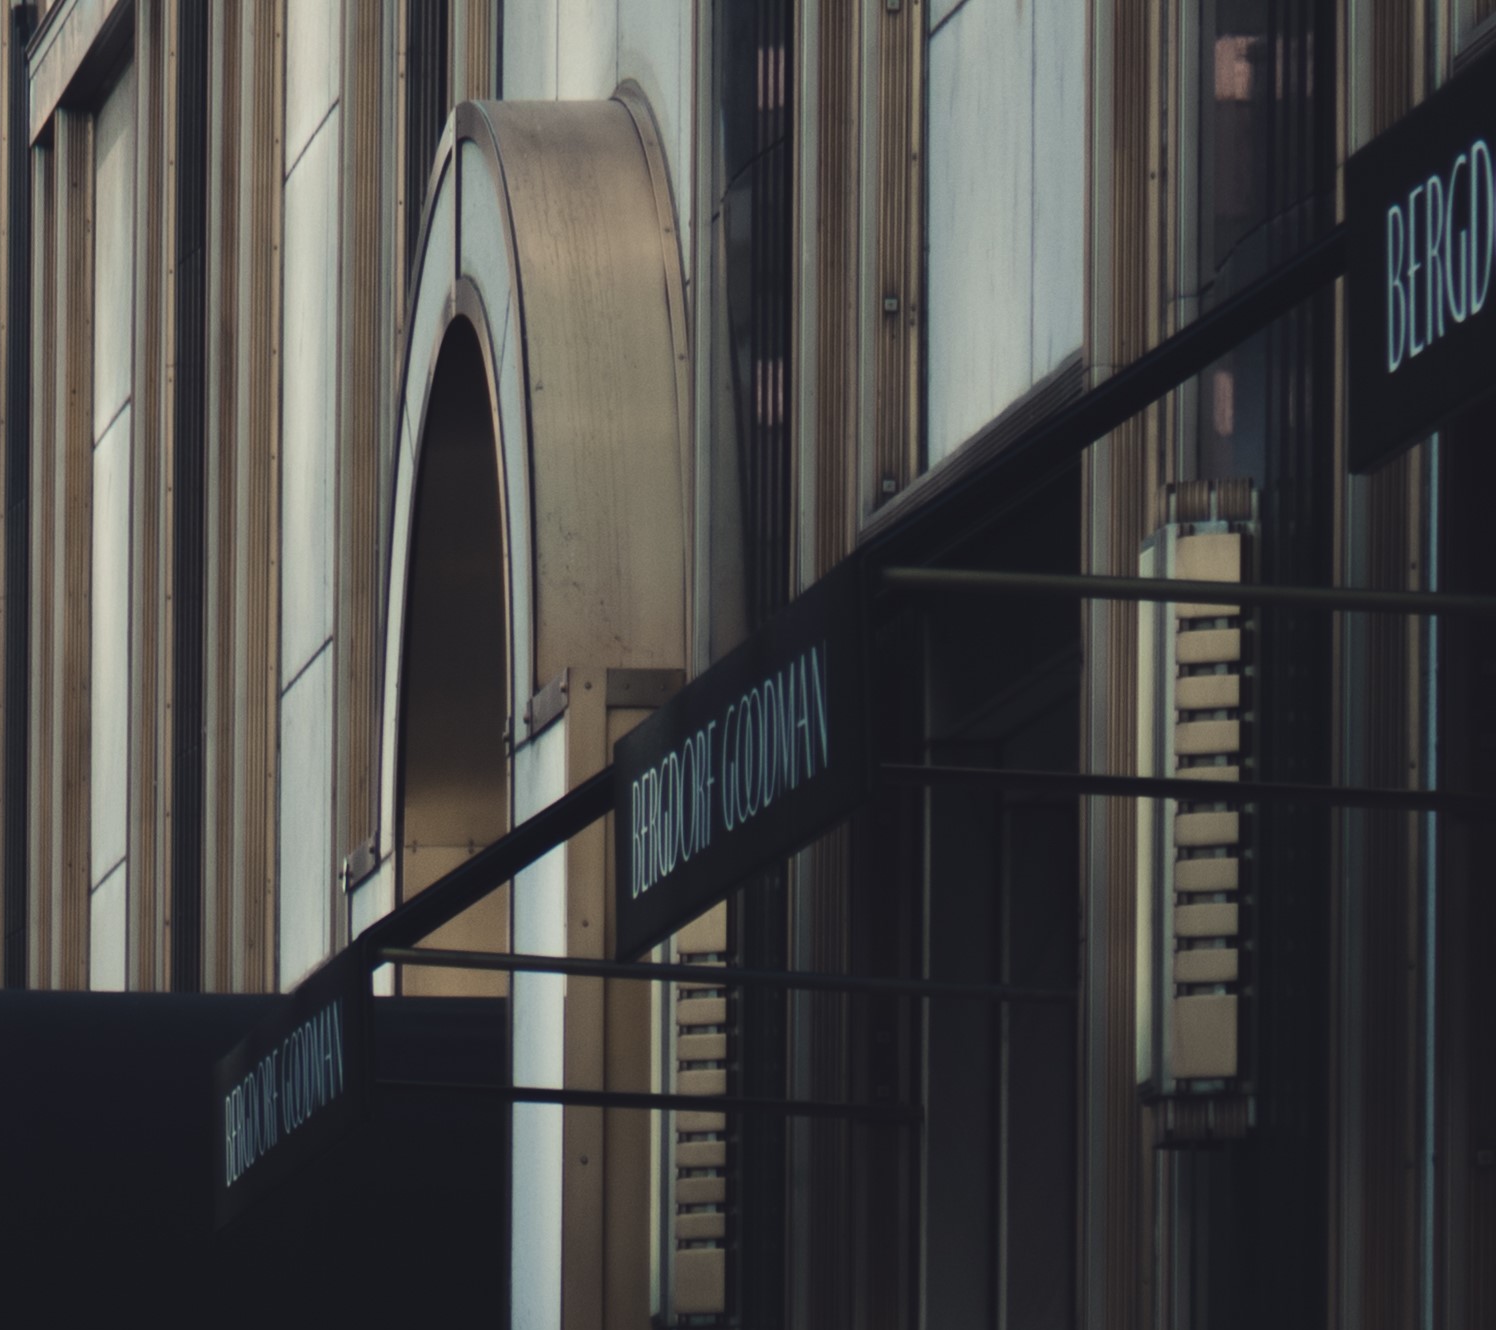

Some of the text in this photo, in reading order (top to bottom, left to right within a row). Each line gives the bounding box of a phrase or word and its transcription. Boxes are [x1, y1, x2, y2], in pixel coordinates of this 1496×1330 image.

[1388, 140, 1496, 373] BERGD
[632, 645, 828, 899] BERGDORF GOODMAN
